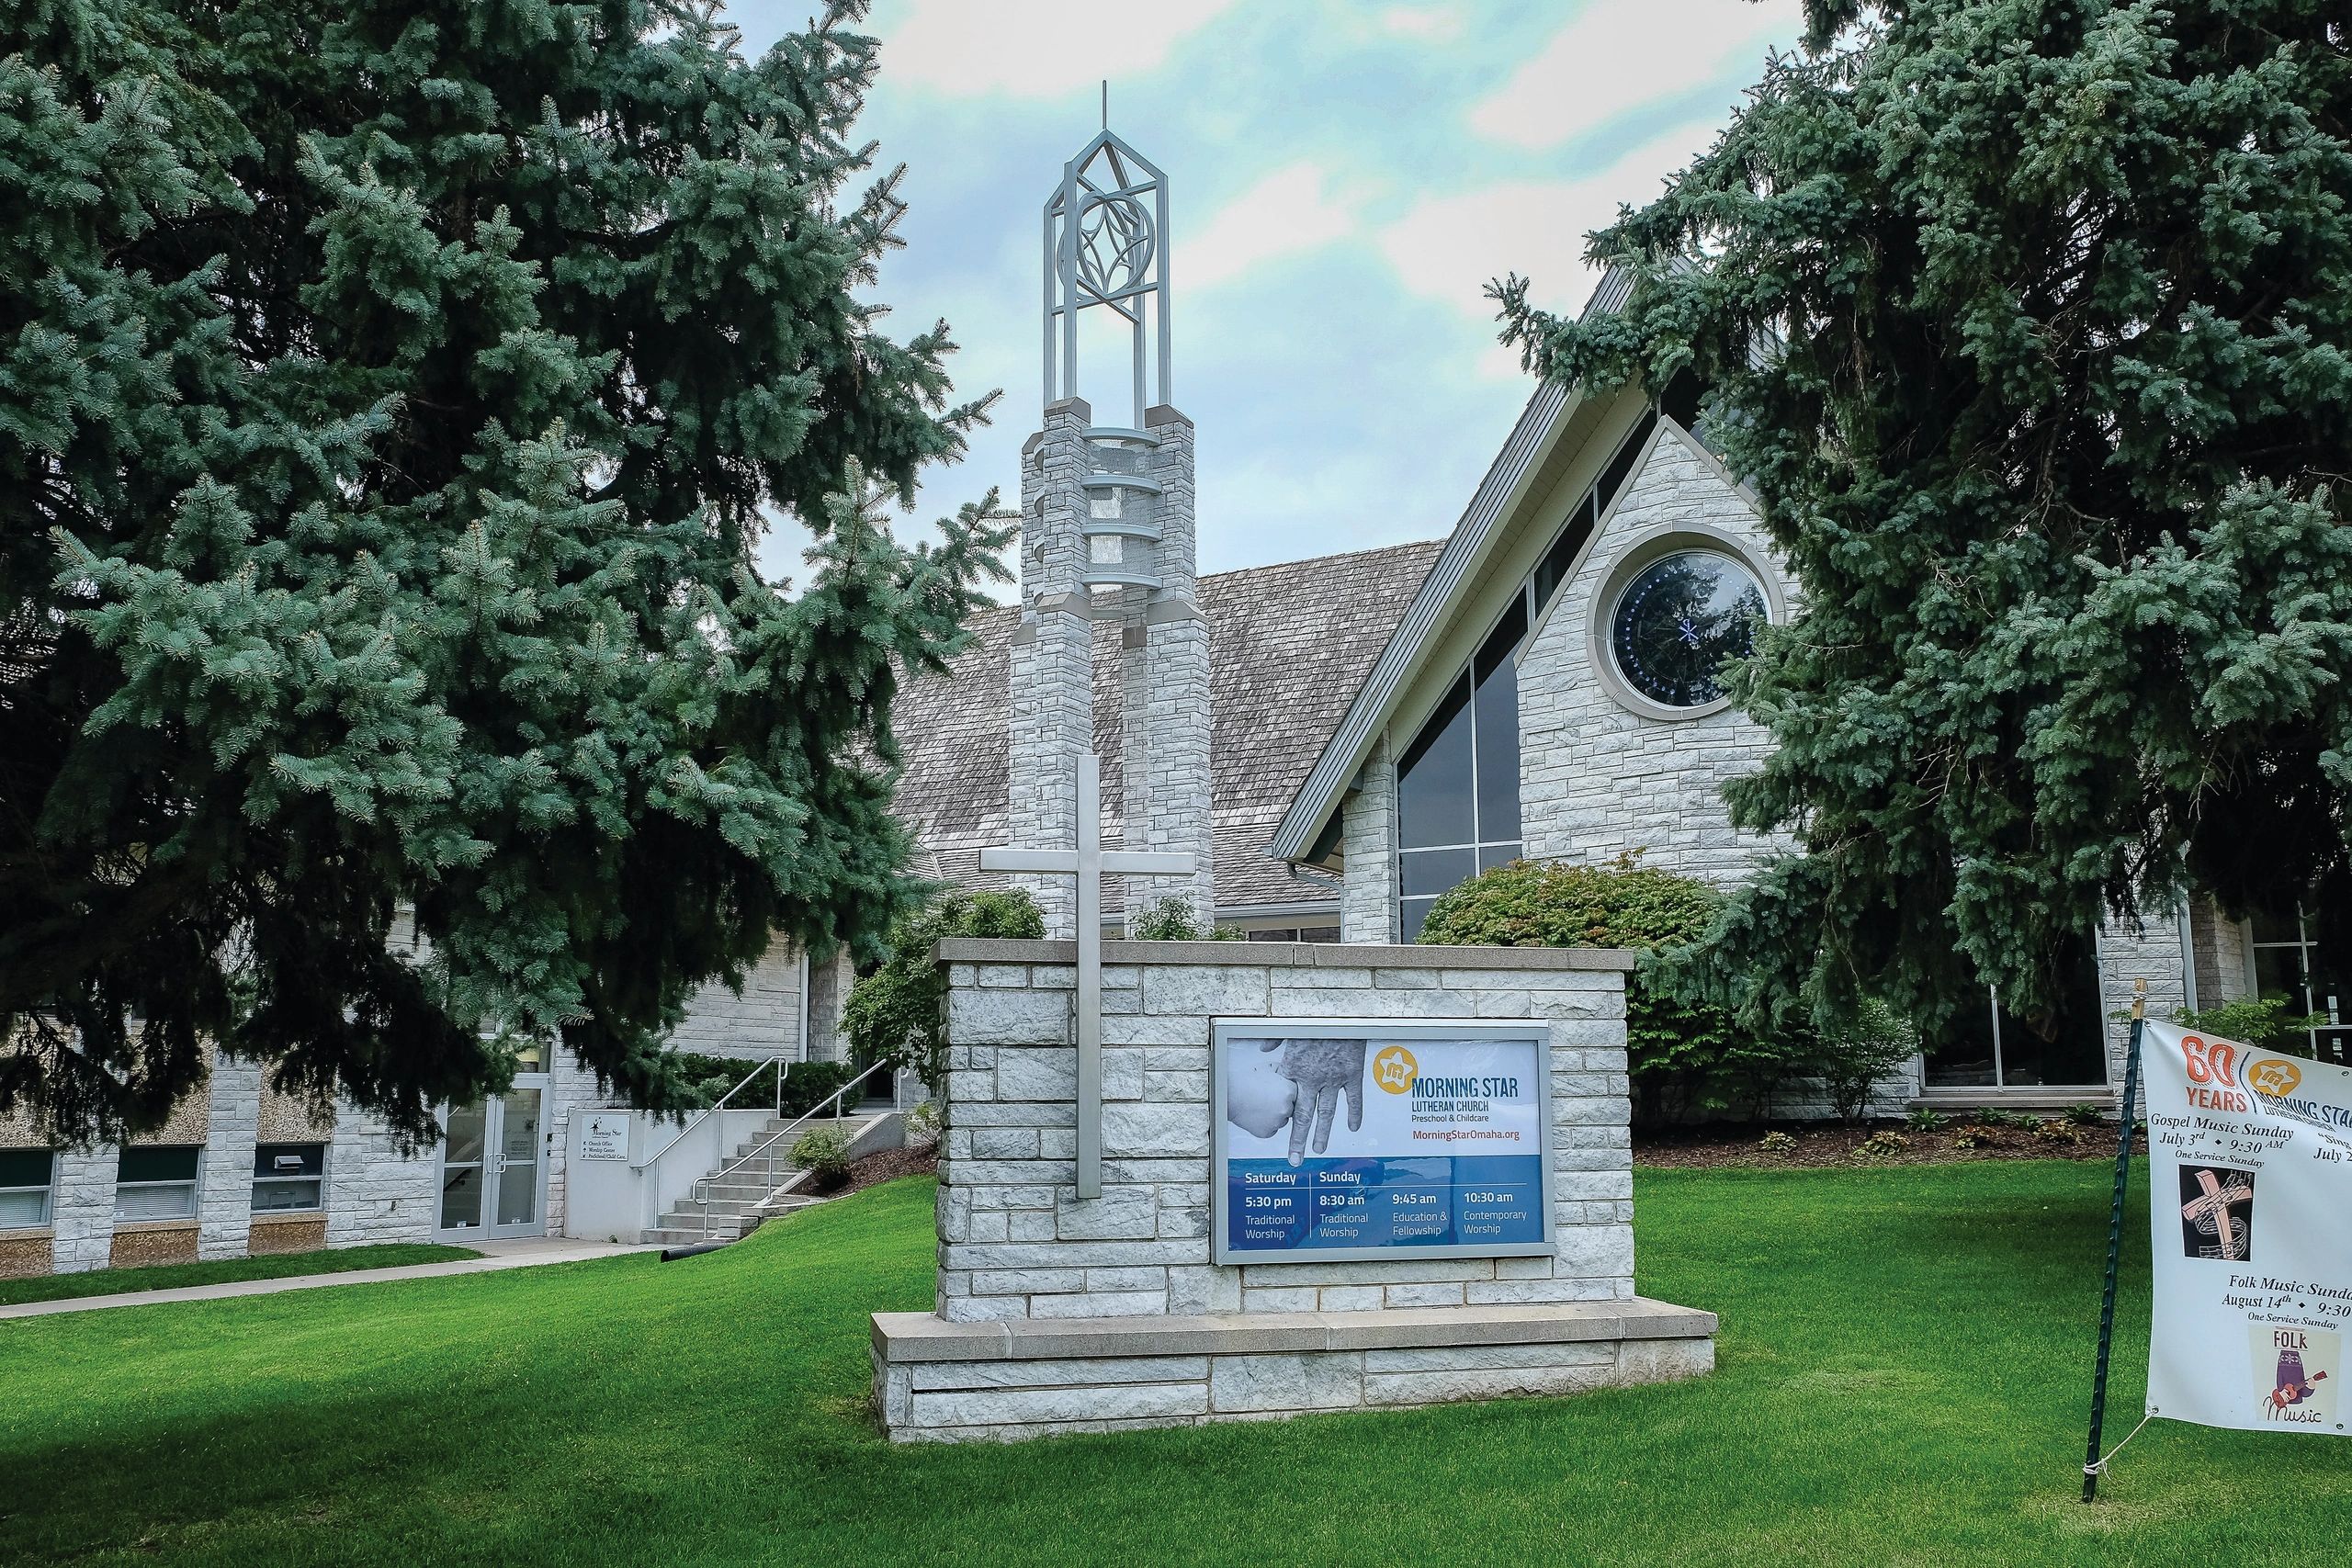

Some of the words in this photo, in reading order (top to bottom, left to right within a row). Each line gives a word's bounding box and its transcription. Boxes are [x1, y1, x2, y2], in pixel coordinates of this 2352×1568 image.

[2181, 1036, 2236, 1088] 60
[1411, 1077, 1478, 1099] MORNING
[1482, 1077, 1519, 1098] STAR
[1411, 1101, 1454, 1112] LUTHERAN
[1456, 1100, 1489, 1111] CHURCH
[2186, 1086, 2247, 1114] YEARS
[2253, 1089, 2319, 1120] MORNING
[2322, 1104, 2352, 1128] STA
[1411, 1114, 1447, 1122] Preschool
[1449, 1114, 1455, 1122] &
[1456, 1113, 1489, 1122] Childcare
[2151, 1113, 2190, 1129] Gospel
[2194, 1117, 2239, 1134] Music
[2242, 1122, 2294, 1141] Sunday
[1412, 1130, 1520, 1141] MorningStarOmaha.org
[2159, 1132, 2185, 1147] July
[2188, 1132, 2205, 1145] 3rd
[2229, 1139, 2262, 1154] 9:30
[2266, 1140, 2284, 1149] AM
[2176, 1150, 2192, 1158] One
[2194, 1151, 2226, 1162] Service
[2228, 1155, 2264, 1168] Sunday
[2313, 1147, 2342, 1164] July
[1245, 1172, 1296, 1185] Saturday
[1319, 1171, 1360, 1184] Sunday
[1245, 1196, 1271, 1207] 5:30
[1274, 1198, 1292, 1209] pm
[1319, 1195, 1345, 1205] 8:30
[1348, 1197, 1364, 1205] am
[1392, 1194, 1417, 1204] 9:45
[1419, 1195, 1436, 1203] am
[1464, 1192, 1494, 1202] 10:30
[1497, 1193, 1513, 1202] am
[1246, 1215, 1295, 1225] Traditional
[1319, 1213, 1368, 1224] Traditional
[1393, 1212, 1438, 1222] Education
[1440, 1211, 1448, 1221] &
[1464, 1211, 1527, 1221] Contemporary
[1246, 1229, 1285, 1240] Worship
[1319, 1227, 1359, 1238] Worship
[1393, 1225, 1442, 1236] Fellowship
[1464, 1224, 1500, 1235] Worship
[2229, 1275, 2256, 1289] Folk
[2260, 1278, 2304, 1293] Music
[2222, 1293, 2263, 1310] August
[2267, 1294, 2291, 1309] 14th
[2317, 1302, 2351, 1318] 9:30
[2247, 1312, 2265, 1321] One
[2267, 1313, 2299, 1325] Service
[2301, 1317, 2338, 1330] Sunday
[2274, 1330, 2308, 1349] FOLK
